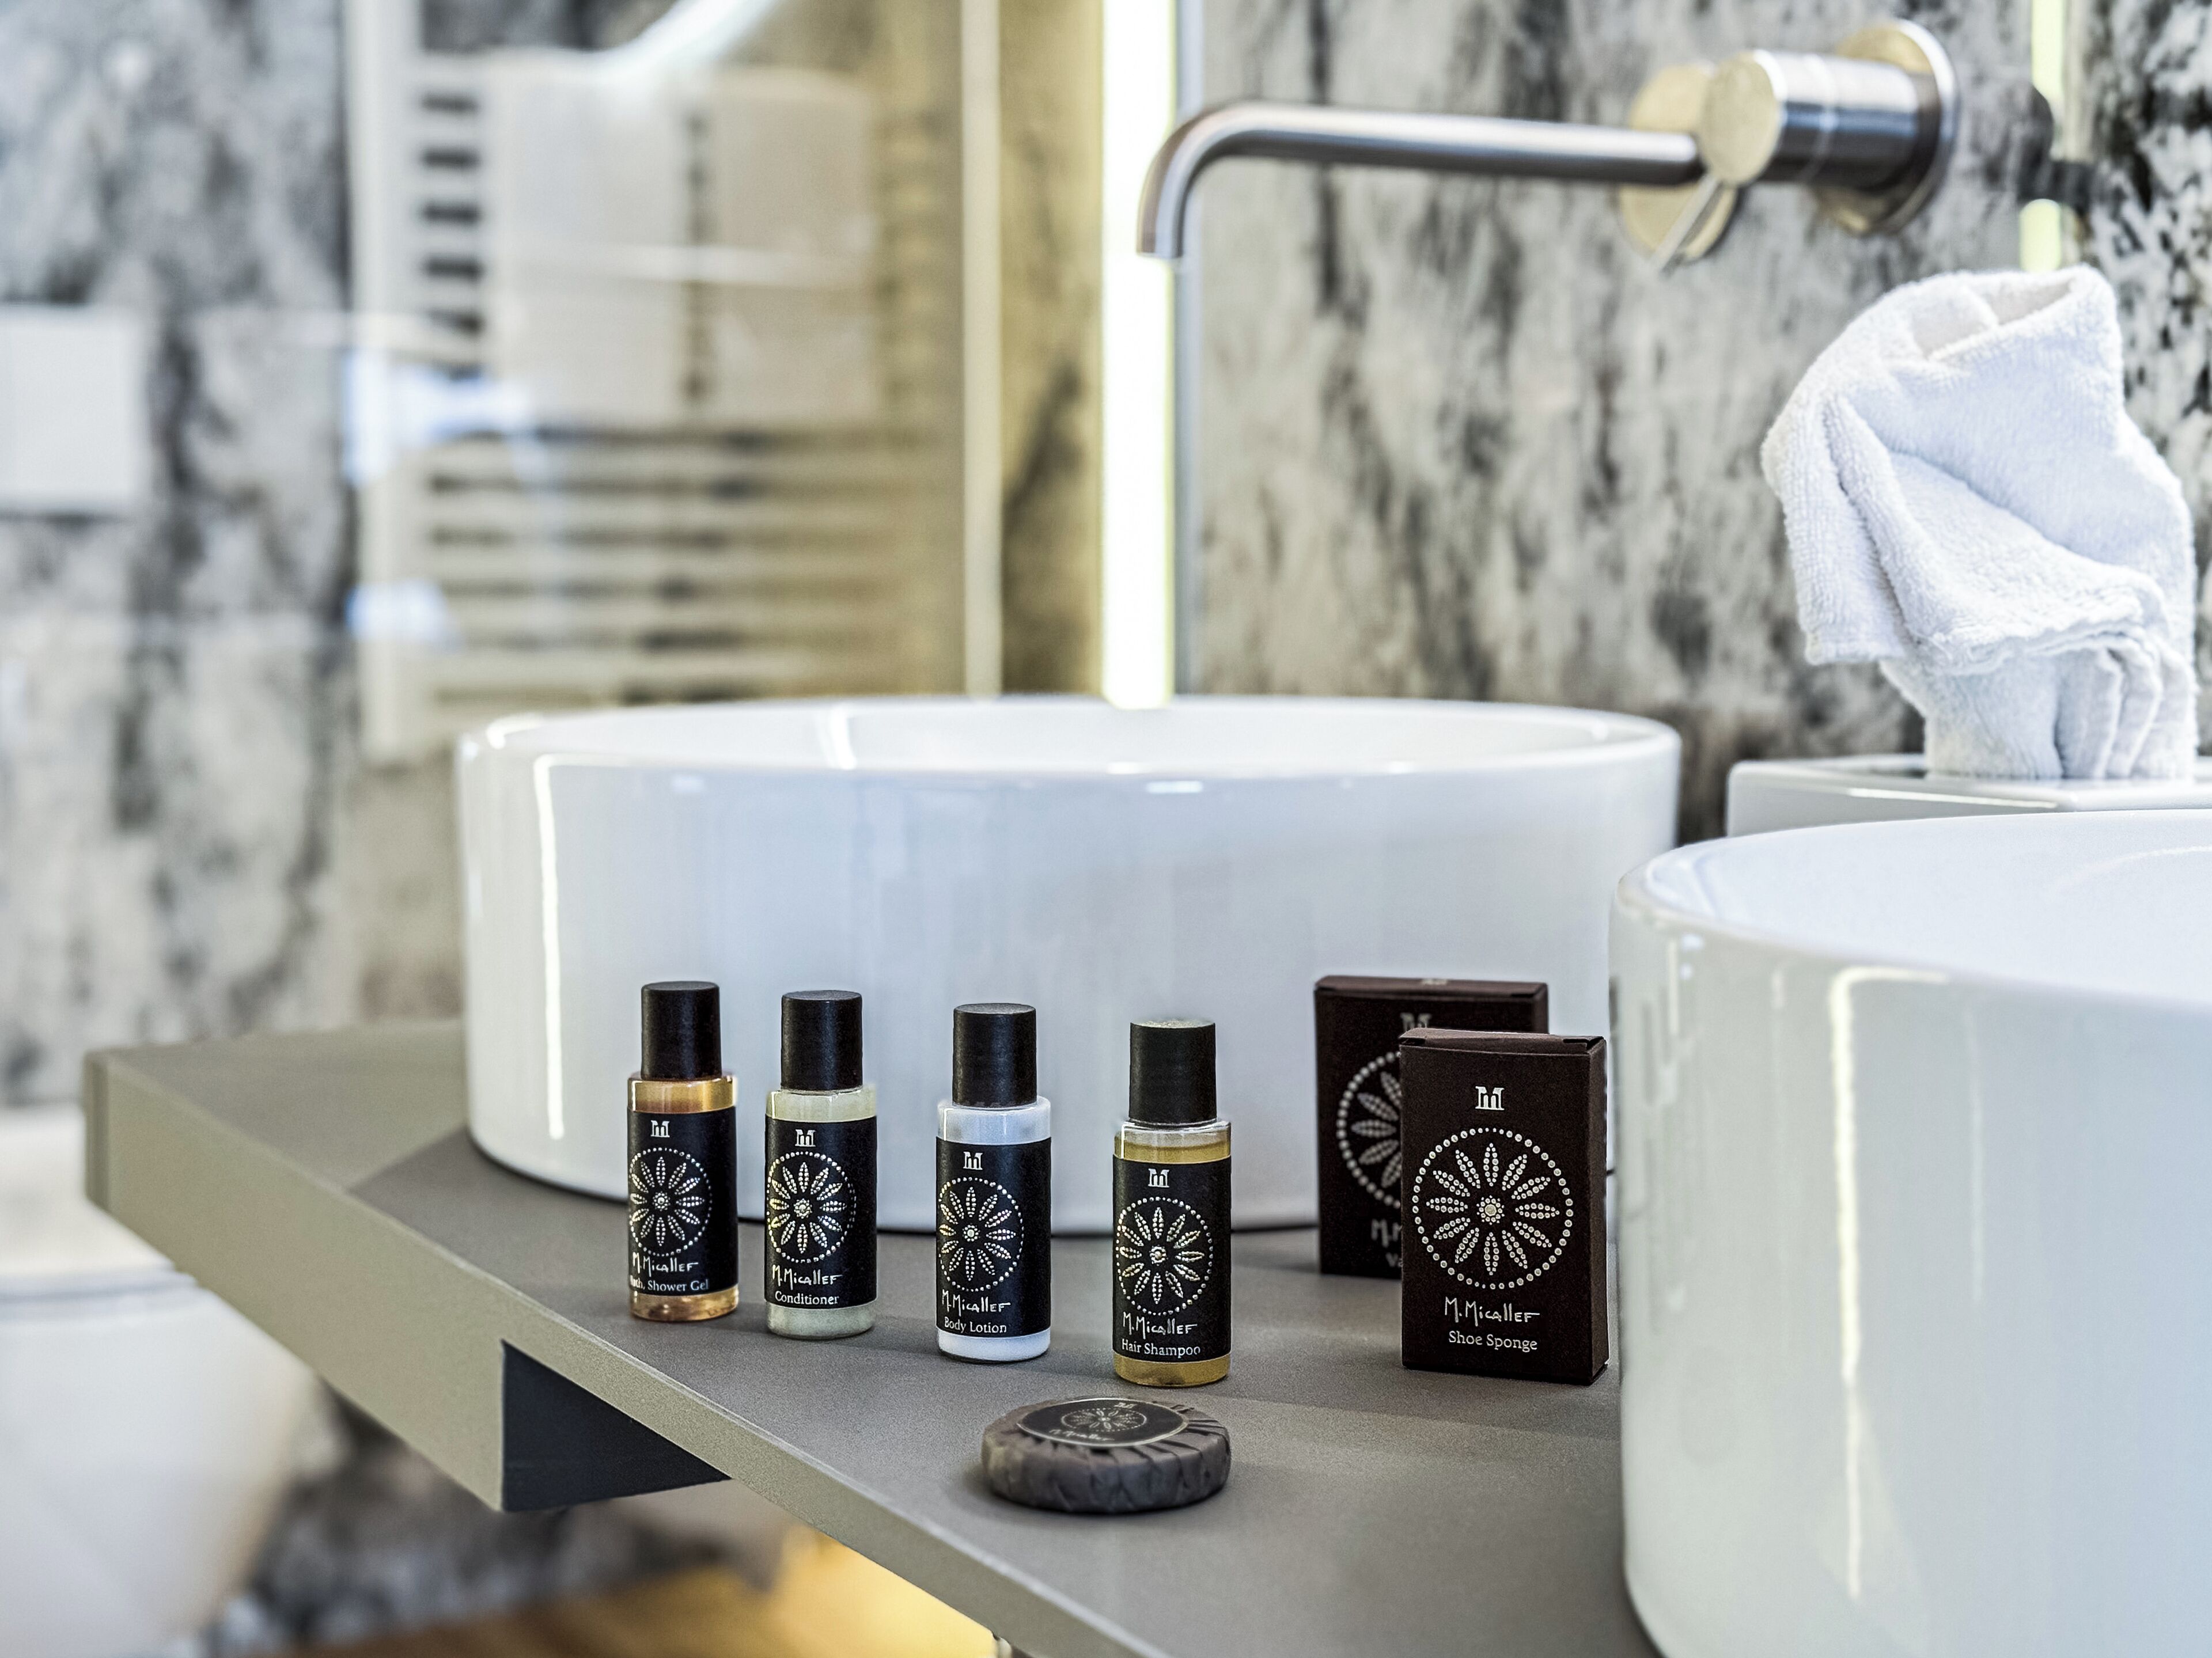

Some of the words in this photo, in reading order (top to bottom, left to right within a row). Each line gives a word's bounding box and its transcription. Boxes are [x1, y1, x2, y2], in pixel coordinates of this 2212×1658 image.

[647, 1280, 687, 1292] Shower
[691, 1278, 709, 1291] Gel
[775, 1291, 839, 1305] Conditioner
[944, 1316, 966, 1333] Body
[970, 1321, 1007, 1333] Lotion
[1122, 1338, 1142, 1353] Hair
[1144, 1343, 1201, 1359] Shampoo
[1448, 1330, 1483, 1345] Shoe
[1486, 1334, 1537, 1353] Sponge
